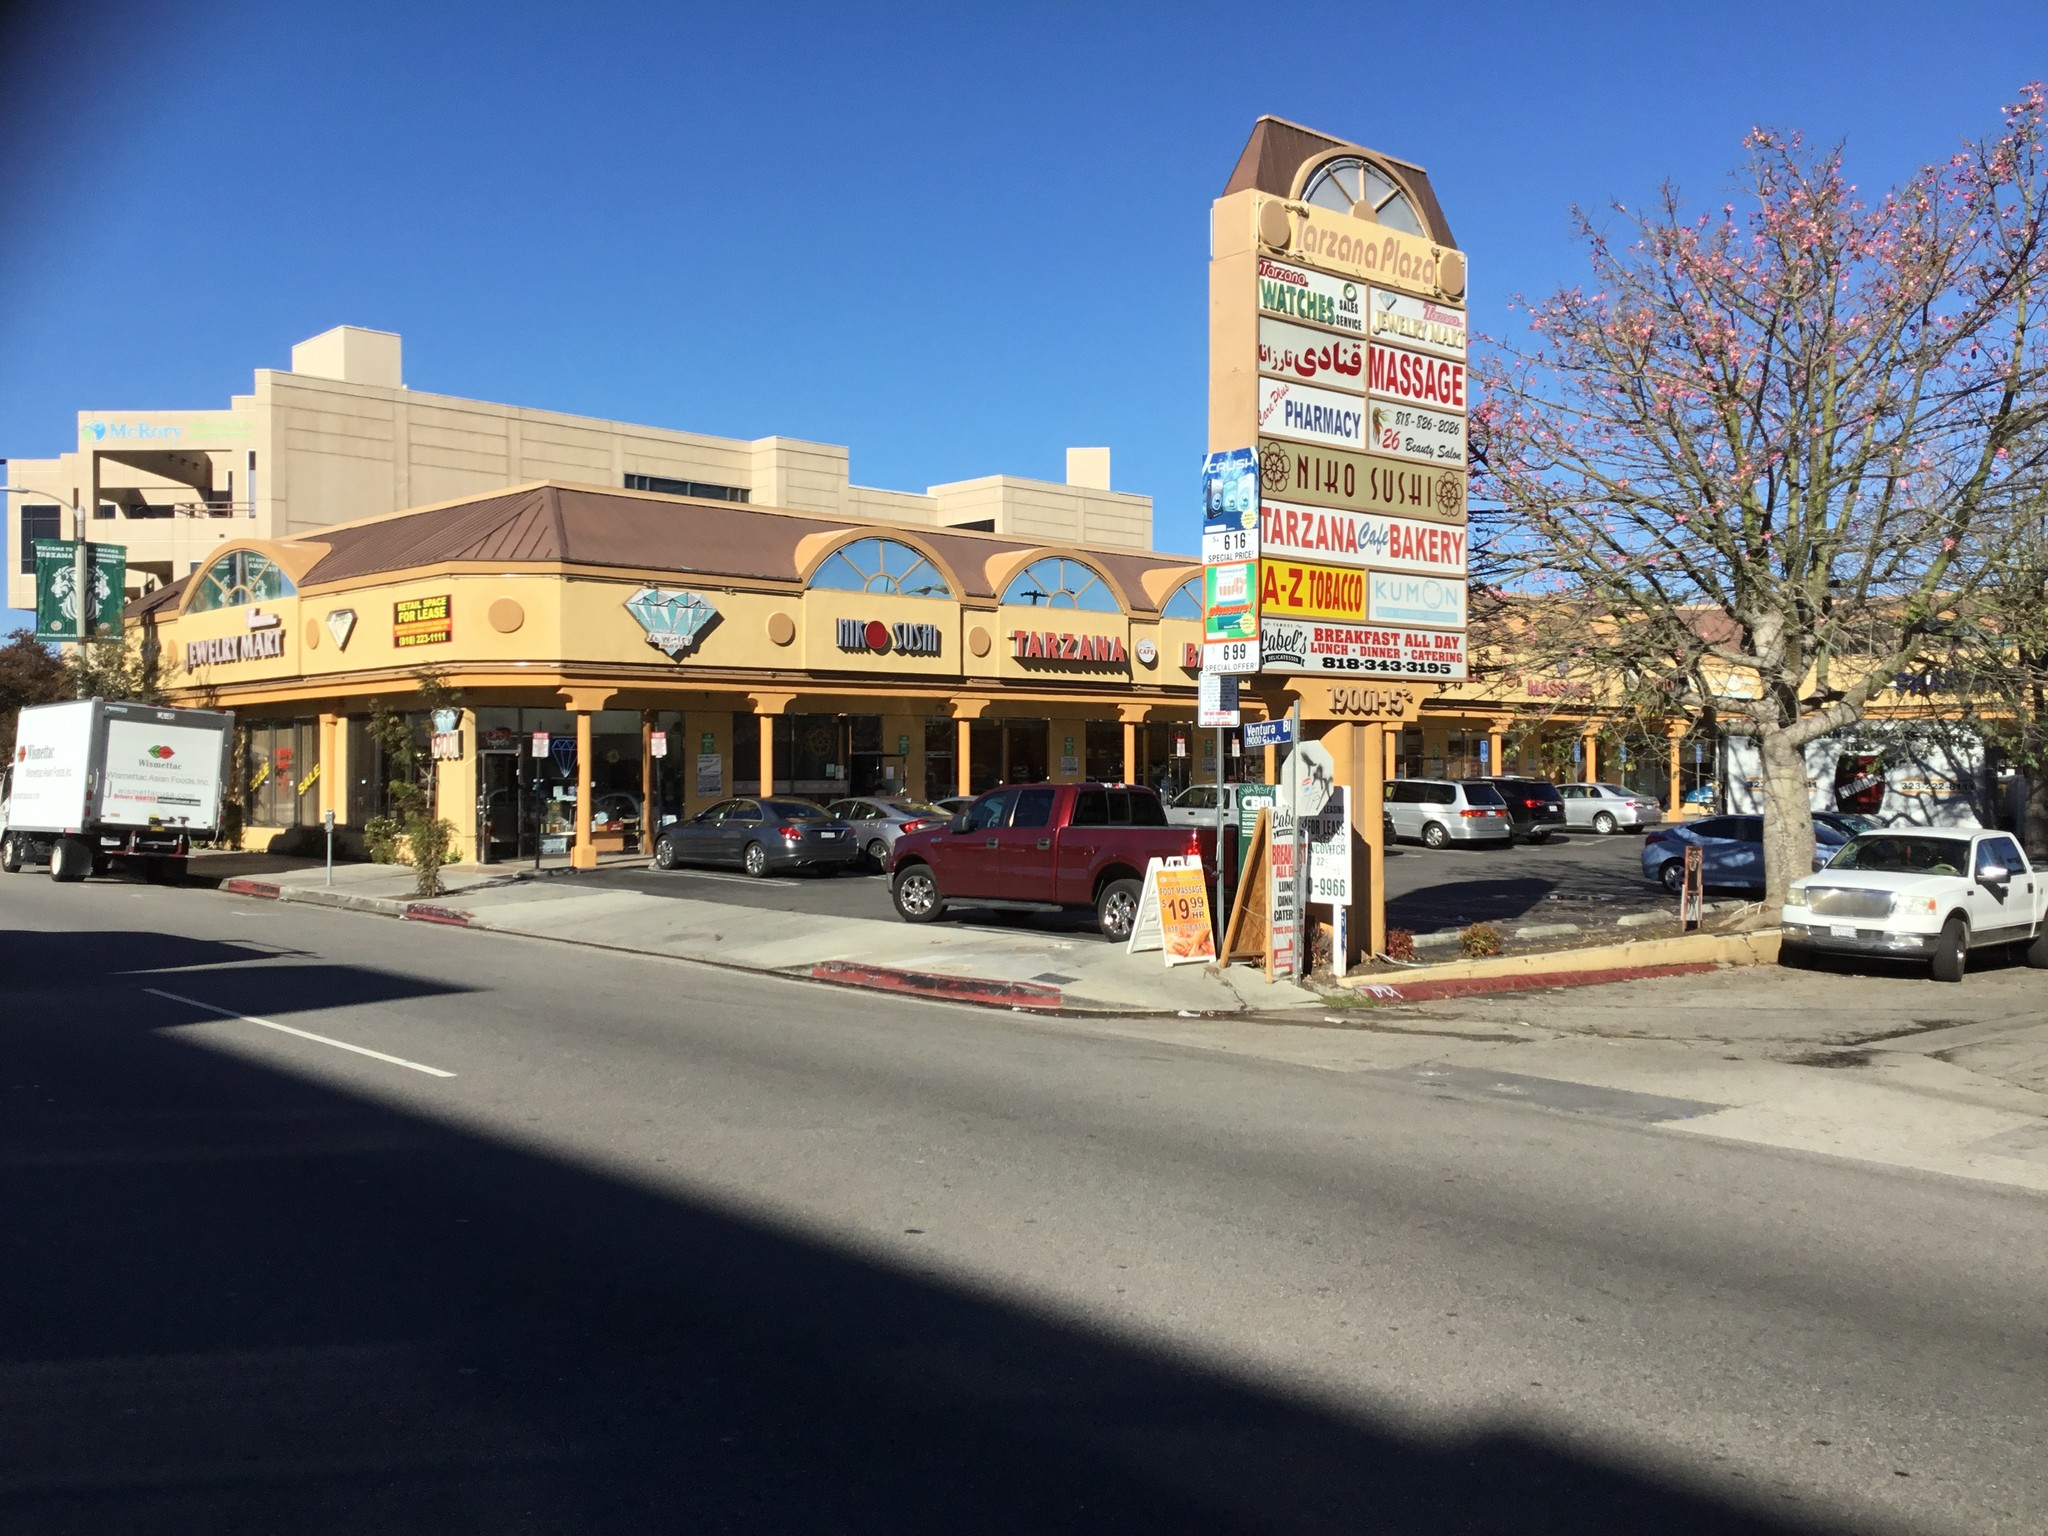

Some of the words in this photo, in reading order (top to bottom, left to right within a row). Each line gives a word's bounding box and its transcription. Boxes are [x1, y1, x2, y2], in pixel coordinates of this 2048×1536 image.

[1296, 218, 1377, 270] Tarzana
[1380, 237, 1436, 286] Plaza
[1259, 259, 1307, 286] Tarzana
[1260, 278, 1335, 325] WATCHES
[1339, 299, 1359, 314] SALES
[1335, 314, 1362, 331] SERVICE
[1372, 310, 1427, 340] JEWELRY
[1429, 323, 1467, 349] MART
[1369, 344, 1463, 406] MASSAGE
[1270, 384, 1290, 405] Plus
[1285, 399, 1361, 439] PHARMACY
[1395, 411, 1460, 435] 818-826-2026
[109, 422, 182, 445] McRory
[1382, 428, 1400, 450] 26
[1405, 437, 1434, 460] Beauty
[1437, 444, 1462, 461] Salon
[1208, 458, 1254, 474] CRUSH
[1297, 453, 1355, 498] NIKO
[1370, 466, 1432, 507] SUSHI
[1260, 506, 1358, 554] TARZANA
[1390, 523, 1464, 566] BAKERY
[1208, 553, 1233, 563] SPECIAL
[1262, 566, 1303, 608] A-Z
[1309, 569, 1363, 613] TOBACCO
[1375, 579, 1458, 609] KUMON
[398, 601, 421, 611] RETAIL
[423, 596, 447, 608] SPACE
[398, 611, 416, 623] FOR
[417, 606, 446, 620] LEASE
[240, 628, 283, 658] MART
[892, 622, 938, 652] SUSHI
[1010, 630, 1126, 663] TARZANA
[1314, 627, 1400, 647] BREAKFAST
[1405, 631, 1431, 649] ALL
[1435, 635, 1460, 650] DAY
[1138, 648, 1154, 656] CAFE
[1310, 642, 1349, 656] LUNCH
[1360, 645, 1401, 660] DINNER
[1411, 649, 1463, 664] CATERING
[1205, 662, 1232, 672] SPECIAL
[1246, 724, 1276, 737] Ventura
[138, 759, 182, 770] Wismettac
[106, 770, 147, 781] Wismettac
[149, 774, 169, 783] Asian
[298, 763, 320, 795] SALE
[1307, 819, 1320, 835] FOR
[1323, 820, 1346, 836] LEASE
[1160, 887, 1175, 896] FOOT
[1176, 884, 1203, 895] MASSAGE
[1192, 910, 1205, 919] HR
